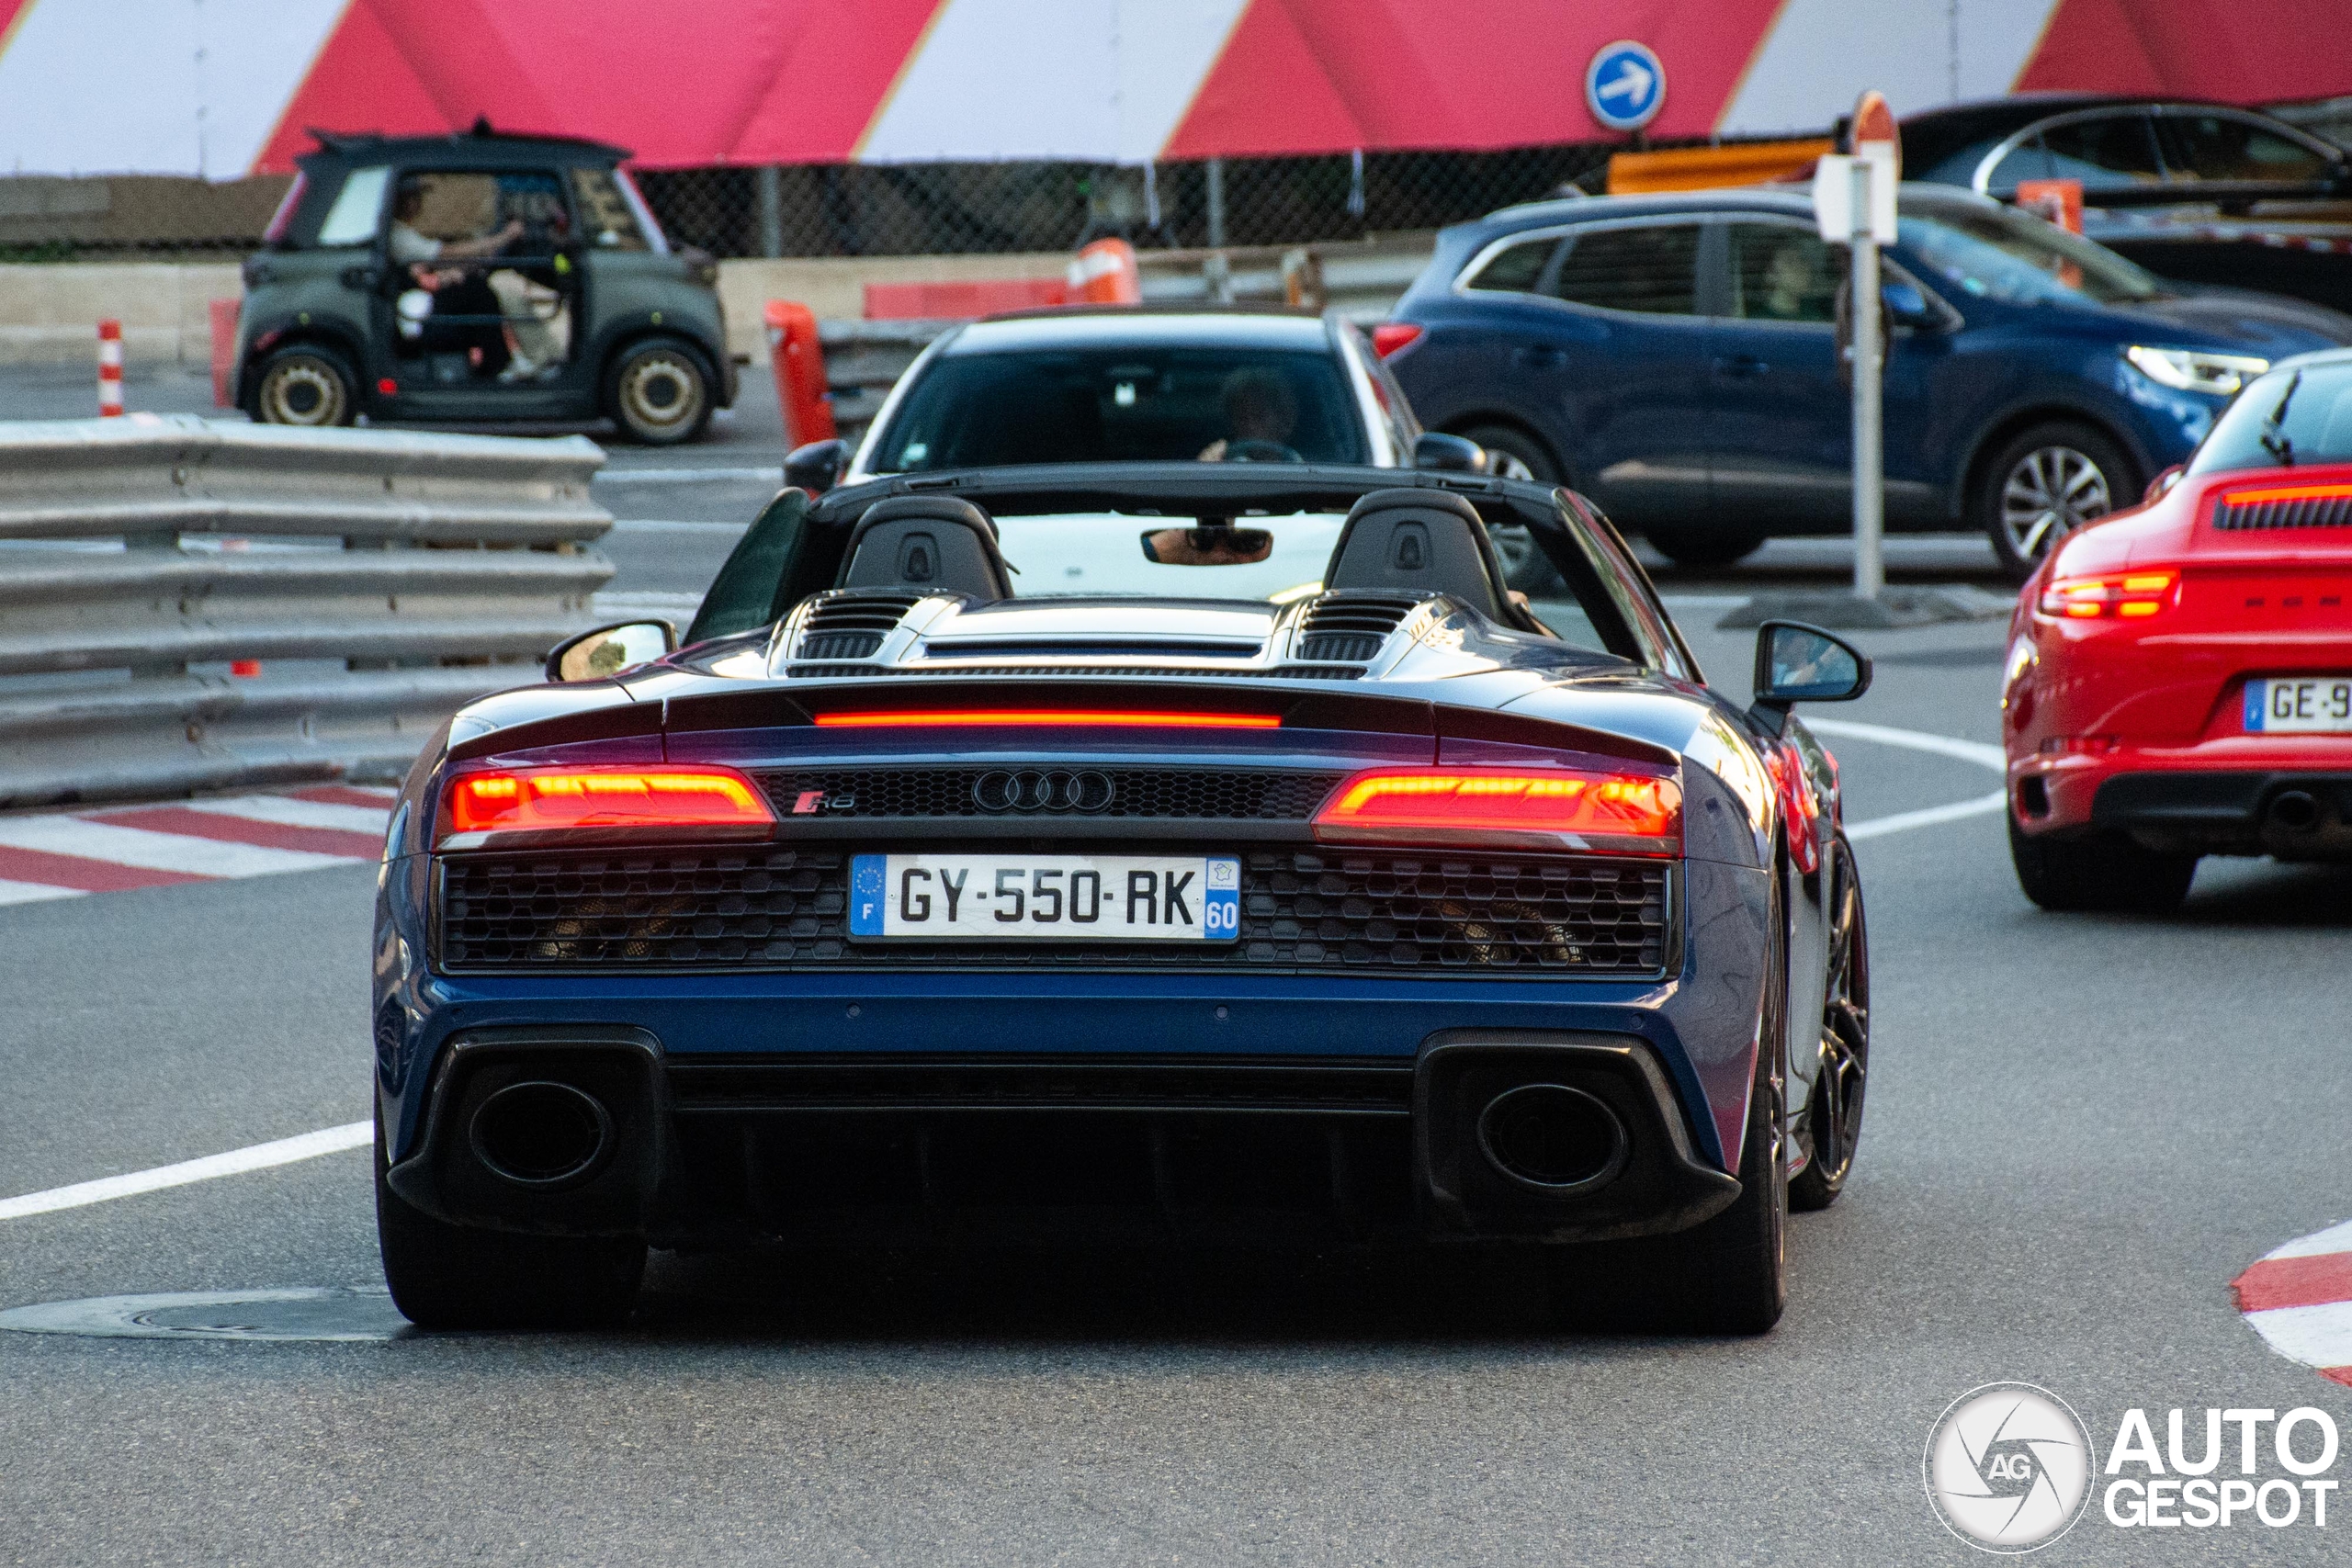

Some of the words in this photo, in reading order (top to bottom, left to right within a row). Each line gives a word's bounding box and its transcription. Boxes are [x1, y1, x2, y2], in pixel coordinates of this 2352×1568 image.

[805, 793, 855, 810] R8
[899, 867, 1195, 925] GY-550-RK
[862, 903, 874, 919] F
[1206, 901, 1237, 929] 60
